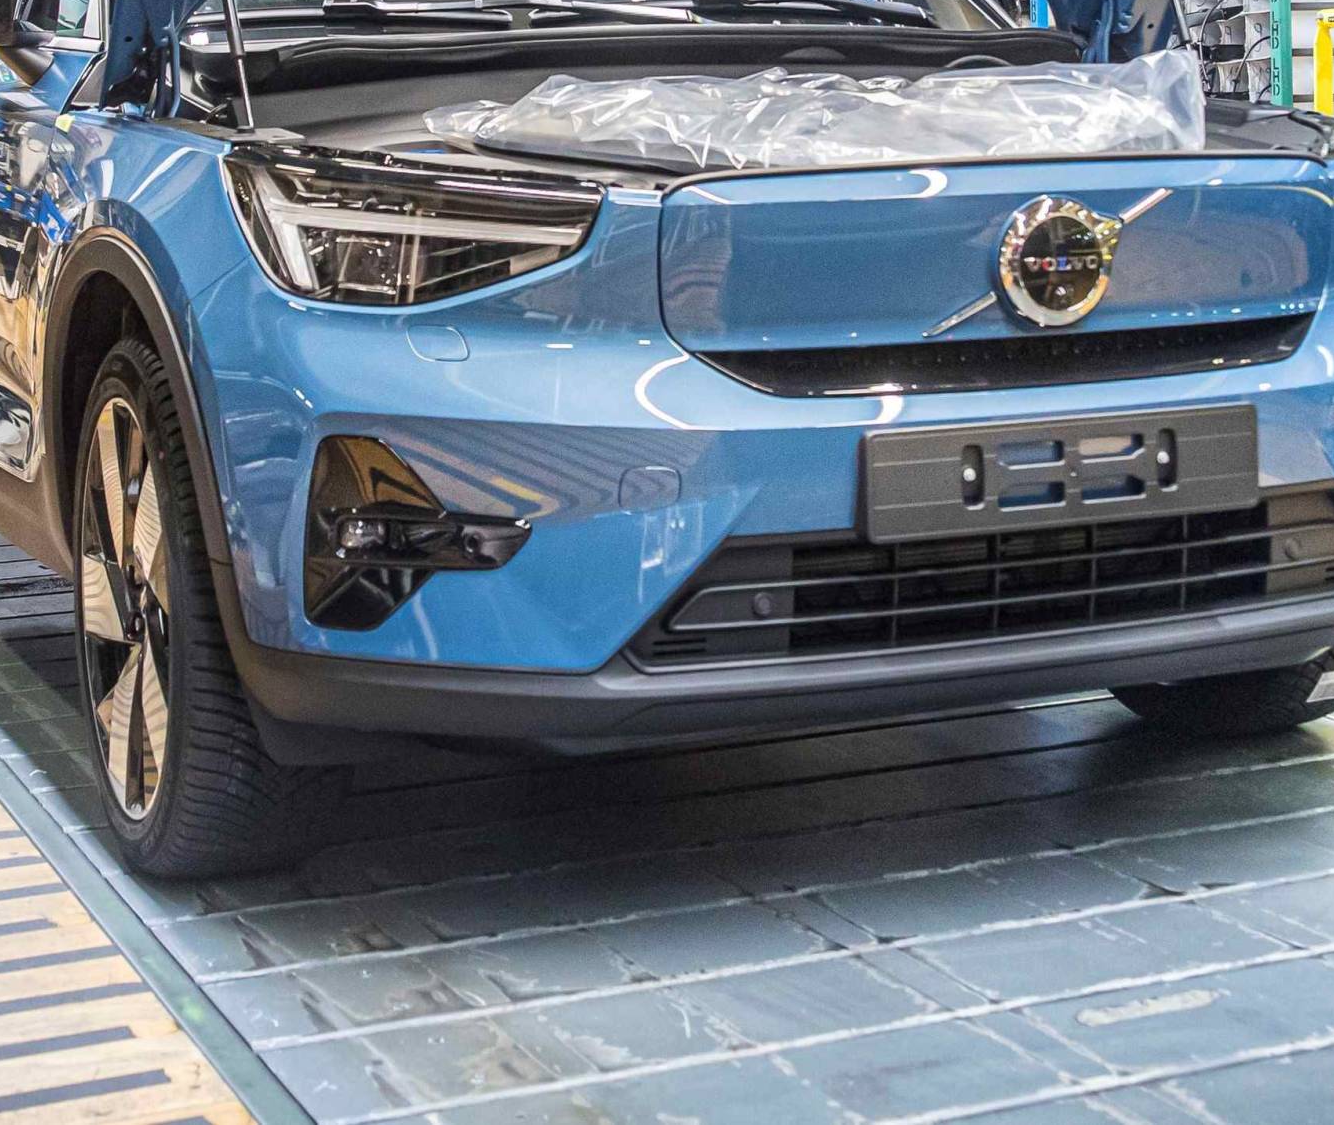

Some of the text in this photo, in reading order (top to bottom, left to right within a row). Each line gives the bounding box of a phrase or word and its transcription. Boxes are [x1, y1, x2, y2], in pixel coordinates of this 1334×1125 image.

[1272, 11, 1280, 50] LHD
[1273, 58, 1281, 97] LHD
[1023, 255, 1099, 272] VOLVO
